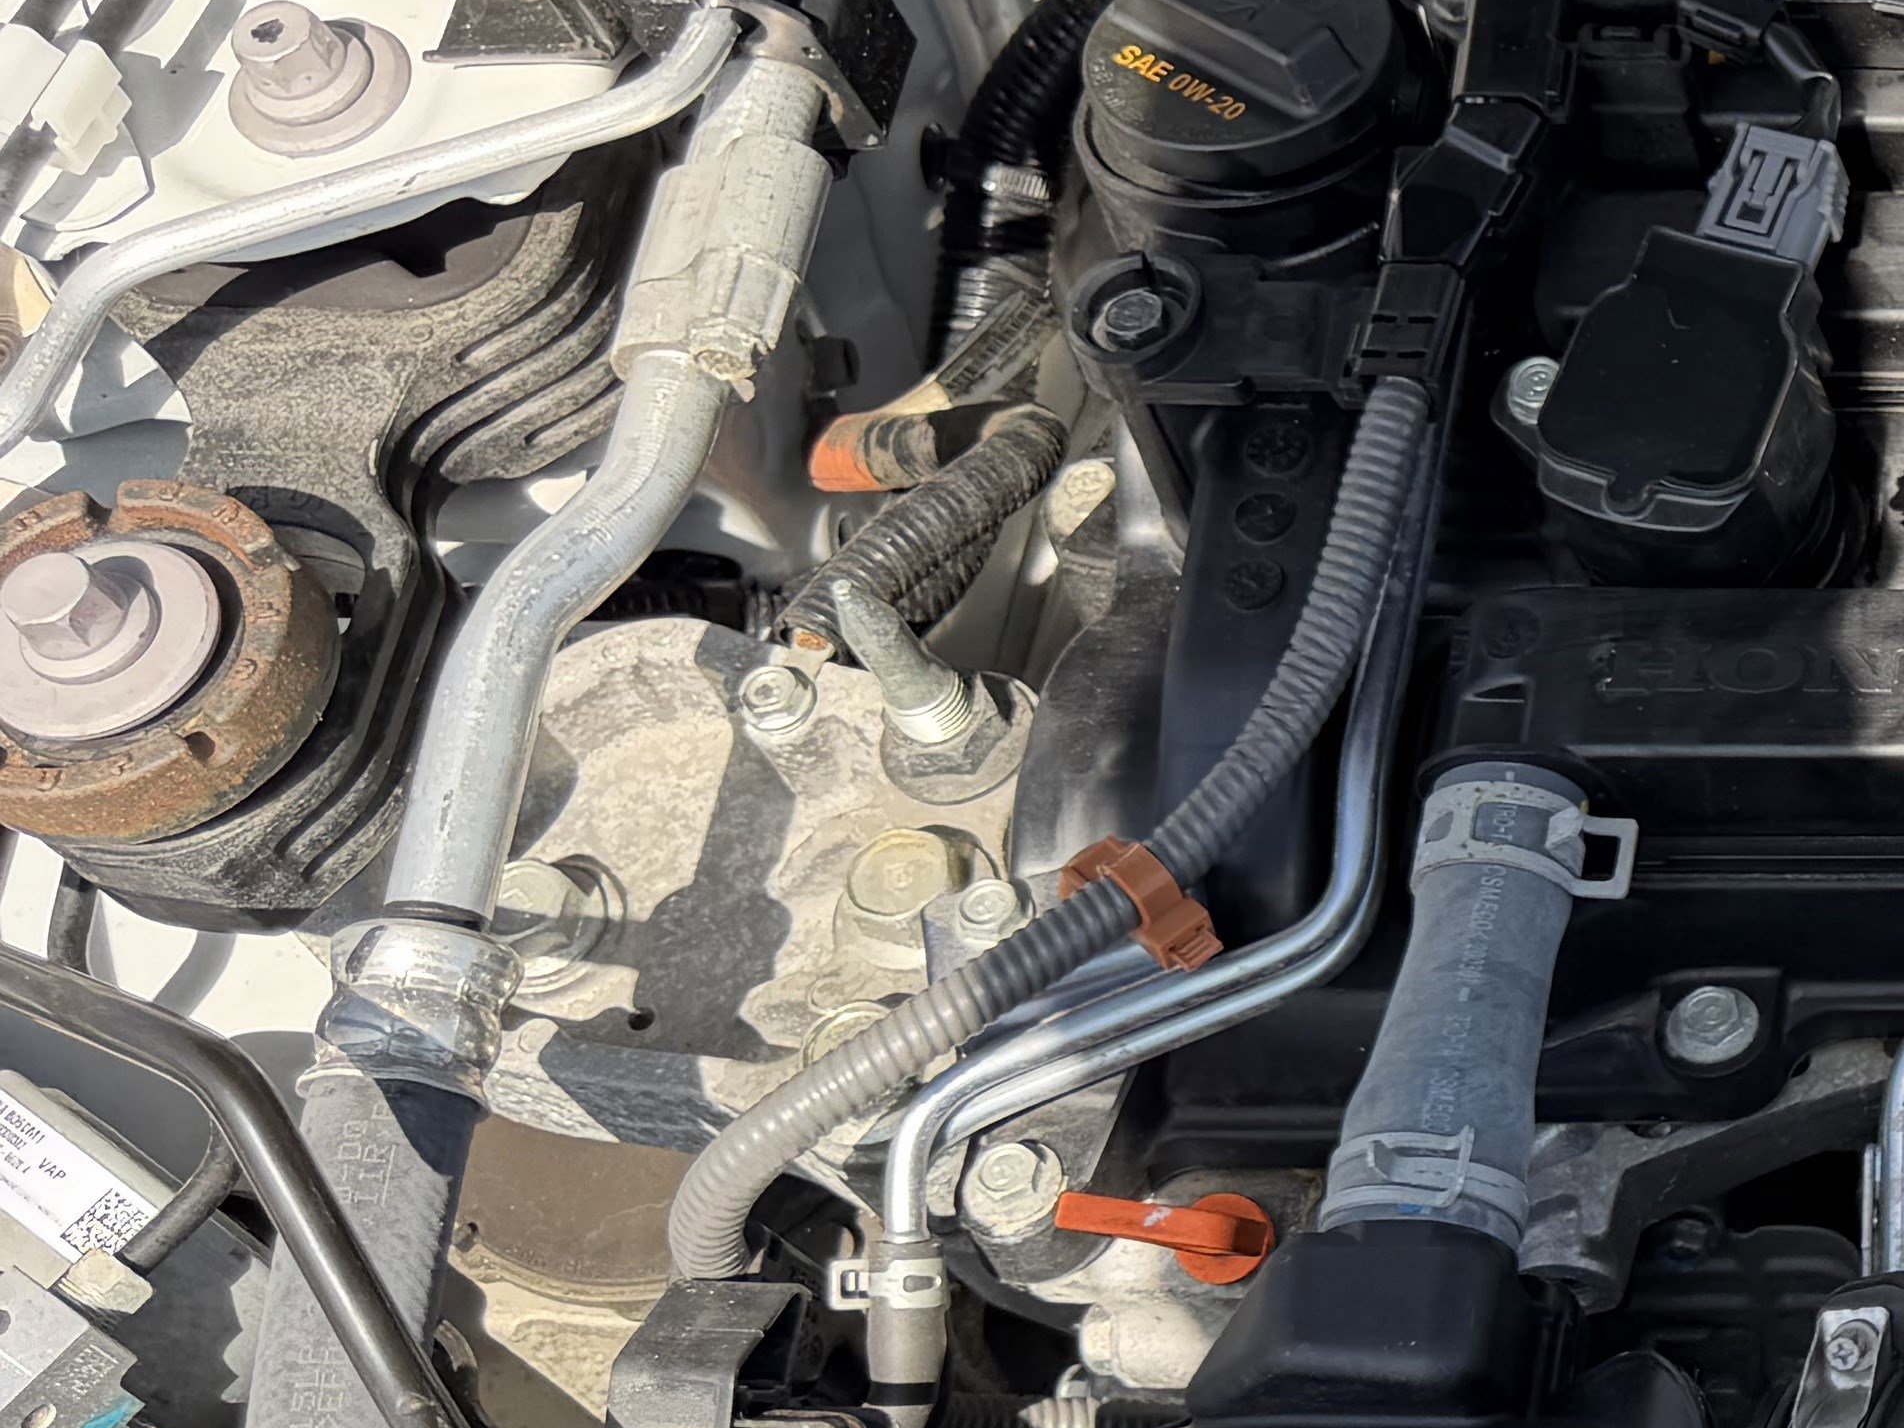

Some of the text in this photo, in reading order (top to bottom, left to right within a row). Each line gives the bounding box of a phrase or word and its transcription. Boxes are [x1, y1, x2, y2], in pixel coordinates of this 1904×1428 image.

[1114, 45, 1246, 121] SAE 0W-20
[38, 1157, 67, 1180] VAP
